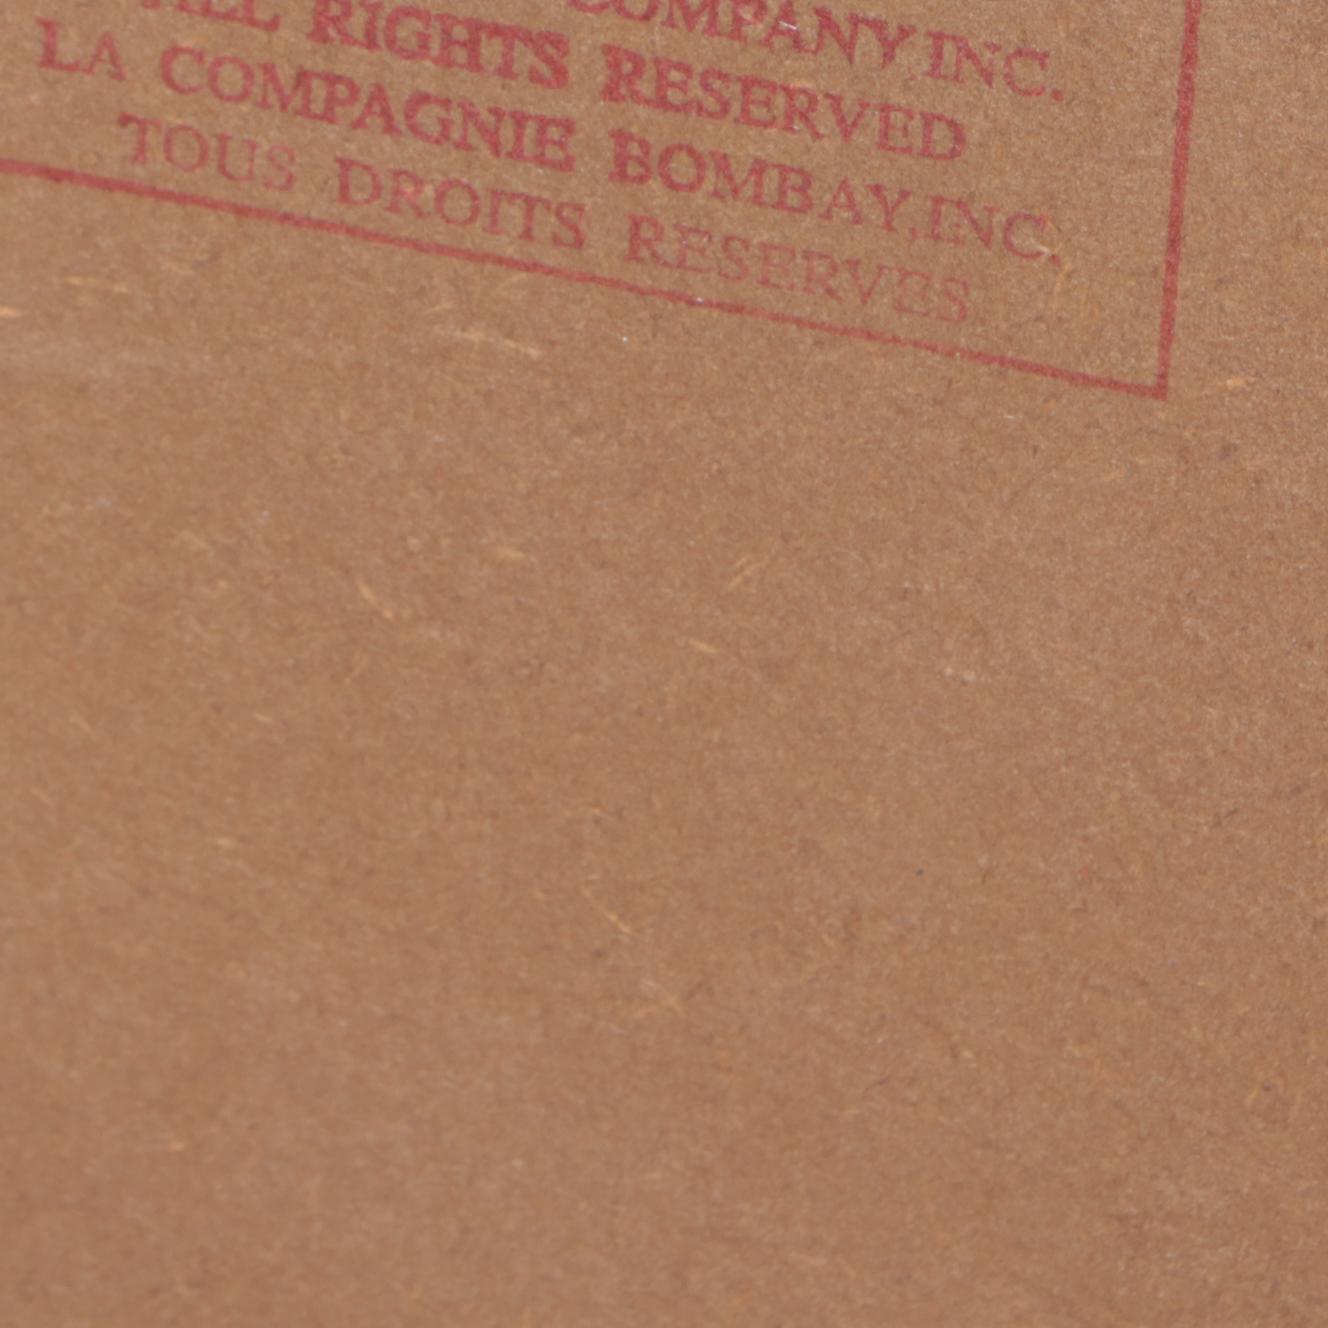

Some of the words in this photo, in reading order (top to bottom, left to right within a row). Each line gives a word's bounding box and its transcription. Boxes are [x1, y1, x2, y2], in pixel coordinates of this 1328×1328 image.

[35, 15, 127, 82] LA
[159, 44, 578, 174] COMPAGNIE
[600, 43, 969, 162] RESERVED
[117, 112, 298, 193] TOUS
[333, 156, 588, 252] DROITS
[624, 212, 972, 324] RESERVES
